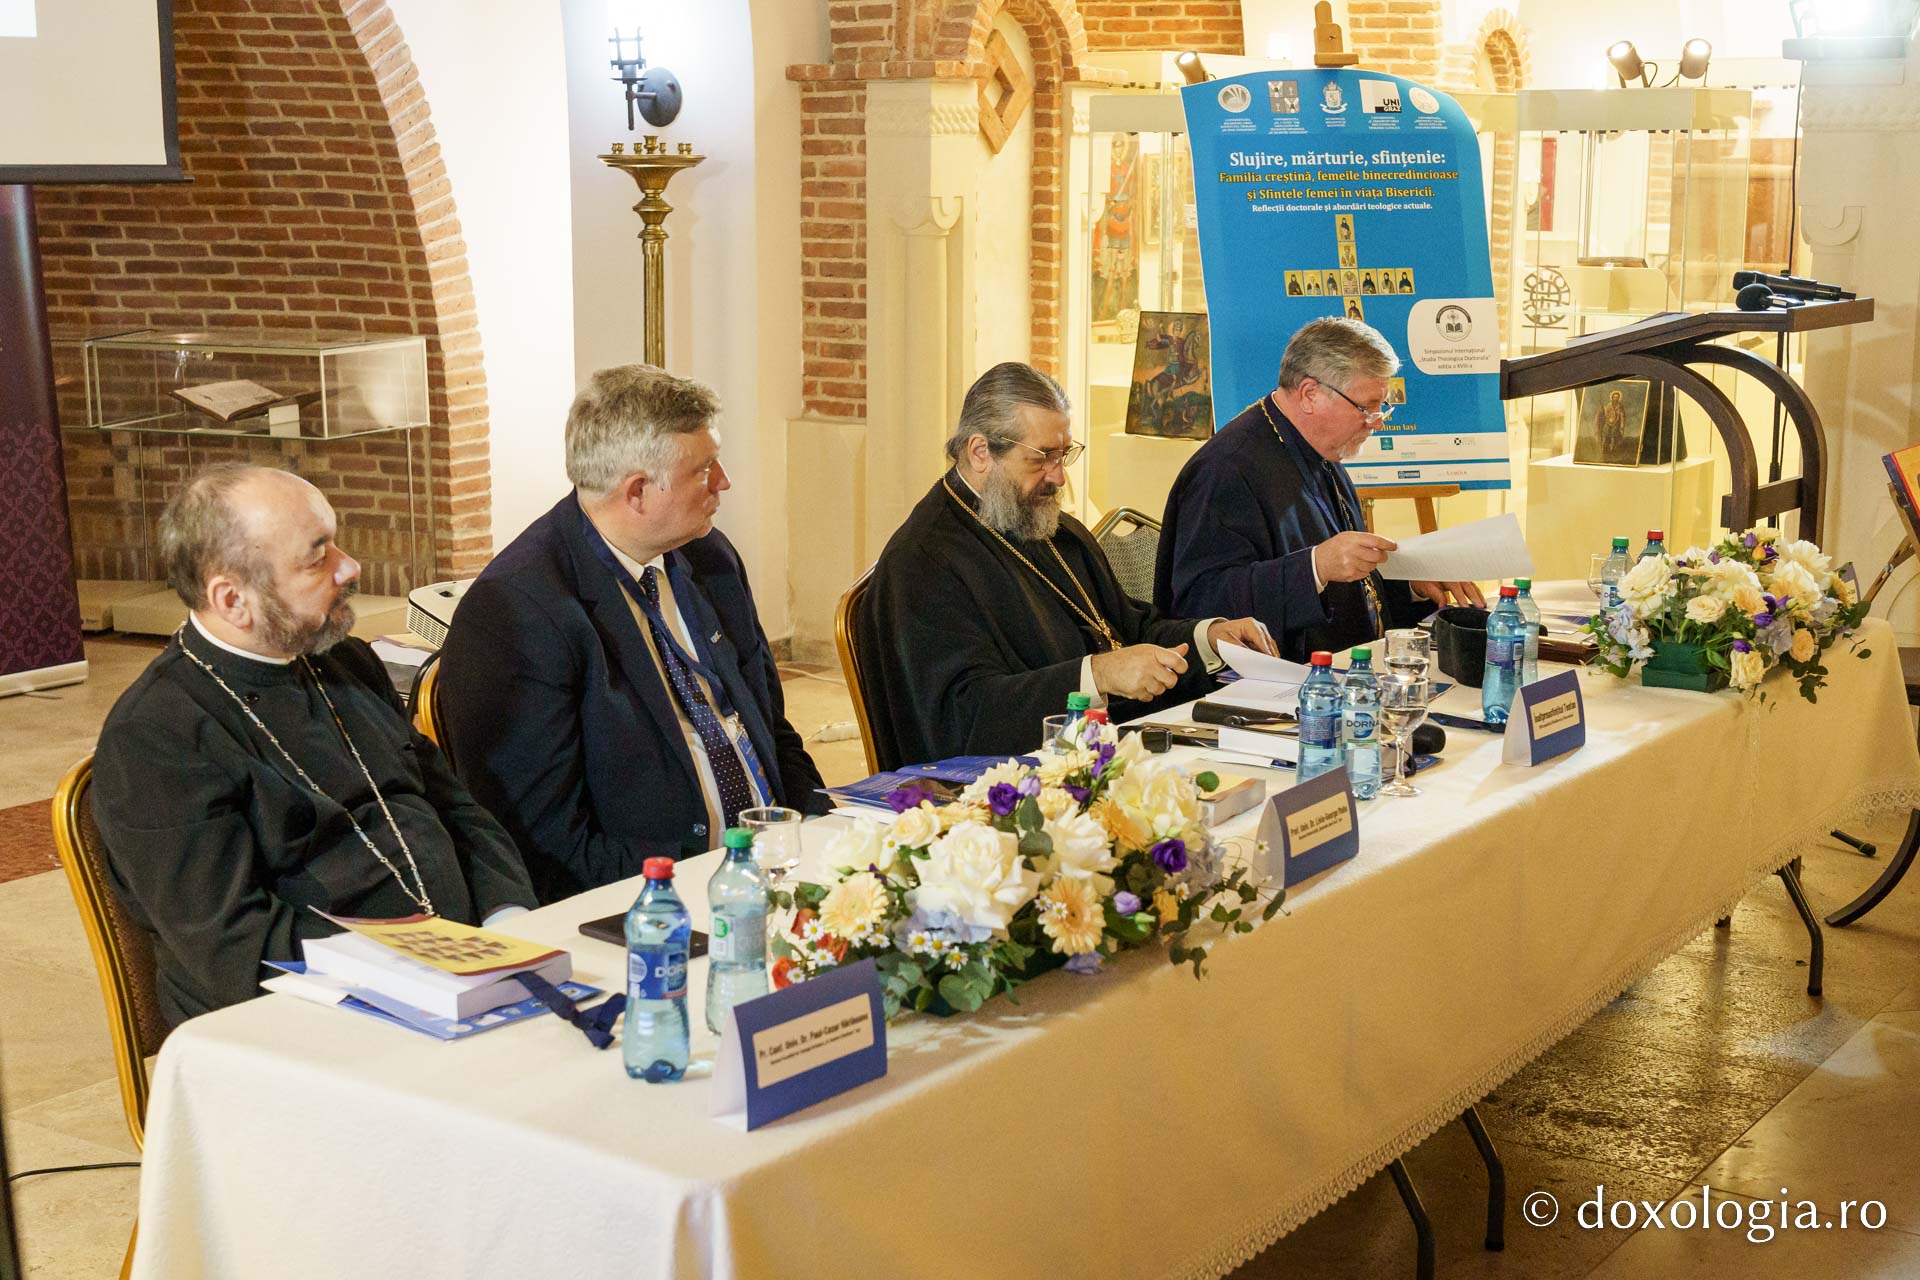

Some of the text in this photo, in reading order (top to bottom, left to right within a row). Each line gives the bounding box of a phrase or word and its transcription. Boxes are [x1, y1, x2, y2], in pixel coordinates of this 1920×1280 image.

[1383, 98, 1400, 106] UNI
[1229, 150, 1446, 169] Slujire, mărturie, sfințenie:
[1219, 169, 1459, 183] Familia creștină, femeile binecredincioase
[1247, 187, 1435, 201] și Sfintele femei în viața Bisericii.
[1252, 202, 1433, 213] Reflecții doctorale și abordări teologice actuale.
